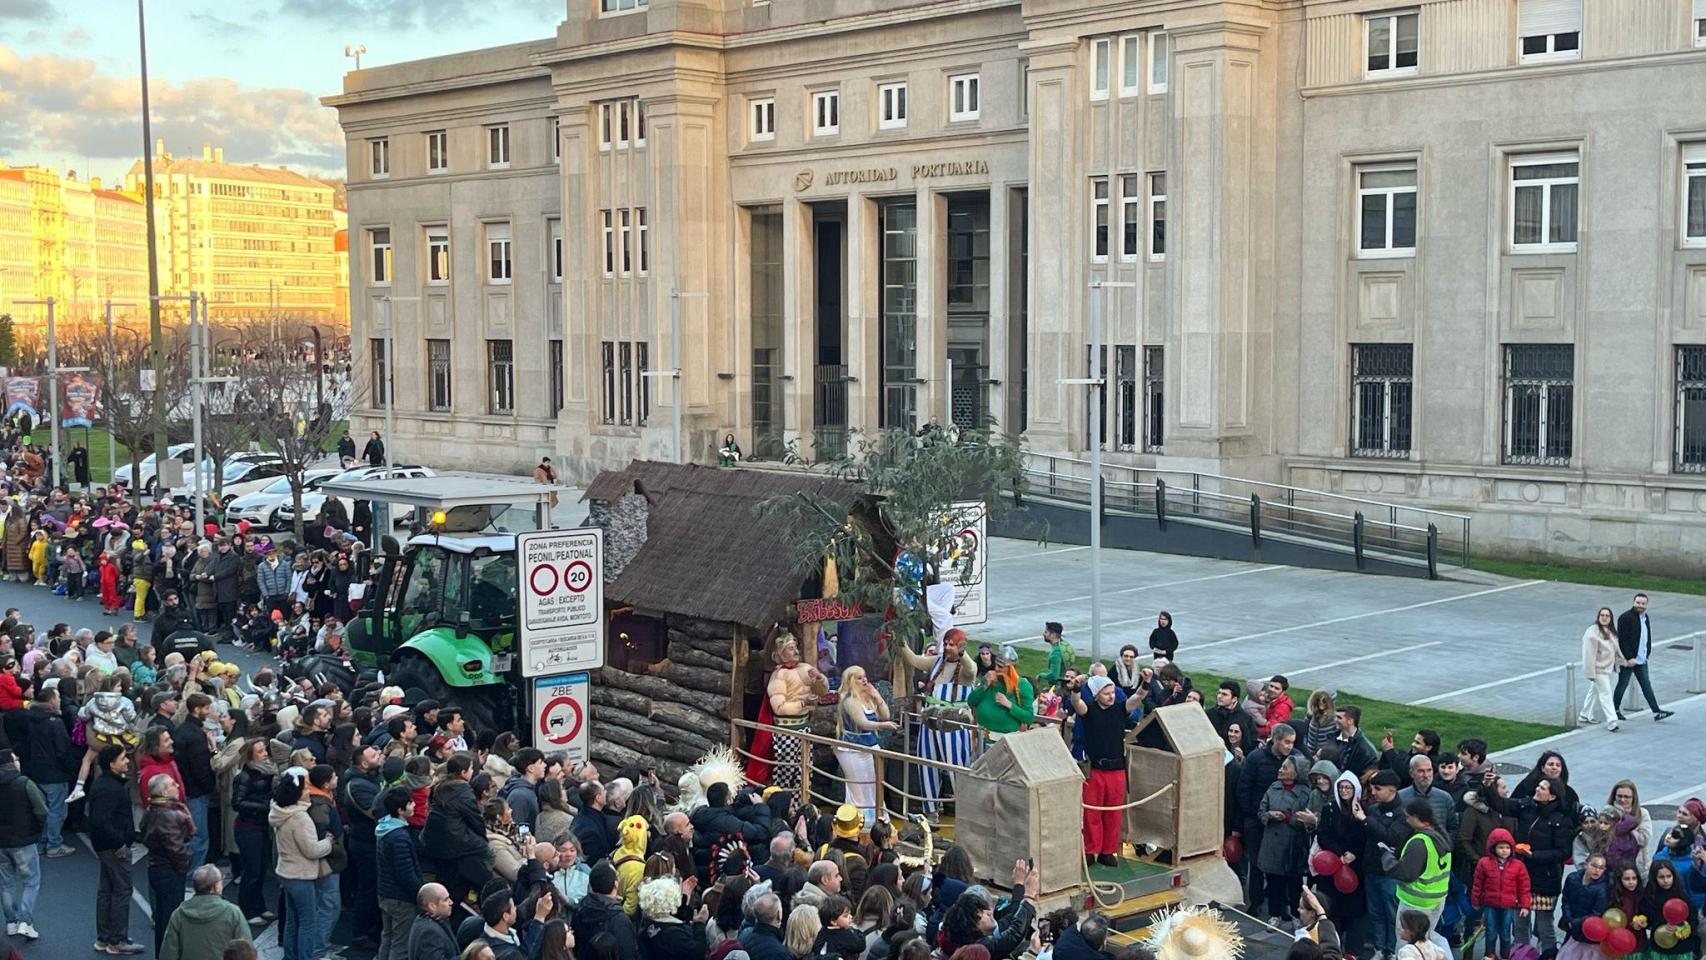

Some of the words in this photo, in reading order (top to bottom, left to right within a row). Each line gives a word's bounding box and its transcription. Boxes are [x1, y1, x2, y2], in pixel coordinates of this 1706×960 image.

[826, 167, 898, 186] AUTORIDAD
[911, 160, 990, 179] PORTUARIA
[529, 543, 548, 551] ZONA
[549, 539, 594, 549] PREFERENCIA
[570, 571, 586, 583] 20
[558, 594, 585, 604] EXCEPTO
[551, 685, 573, 696] ZBE
